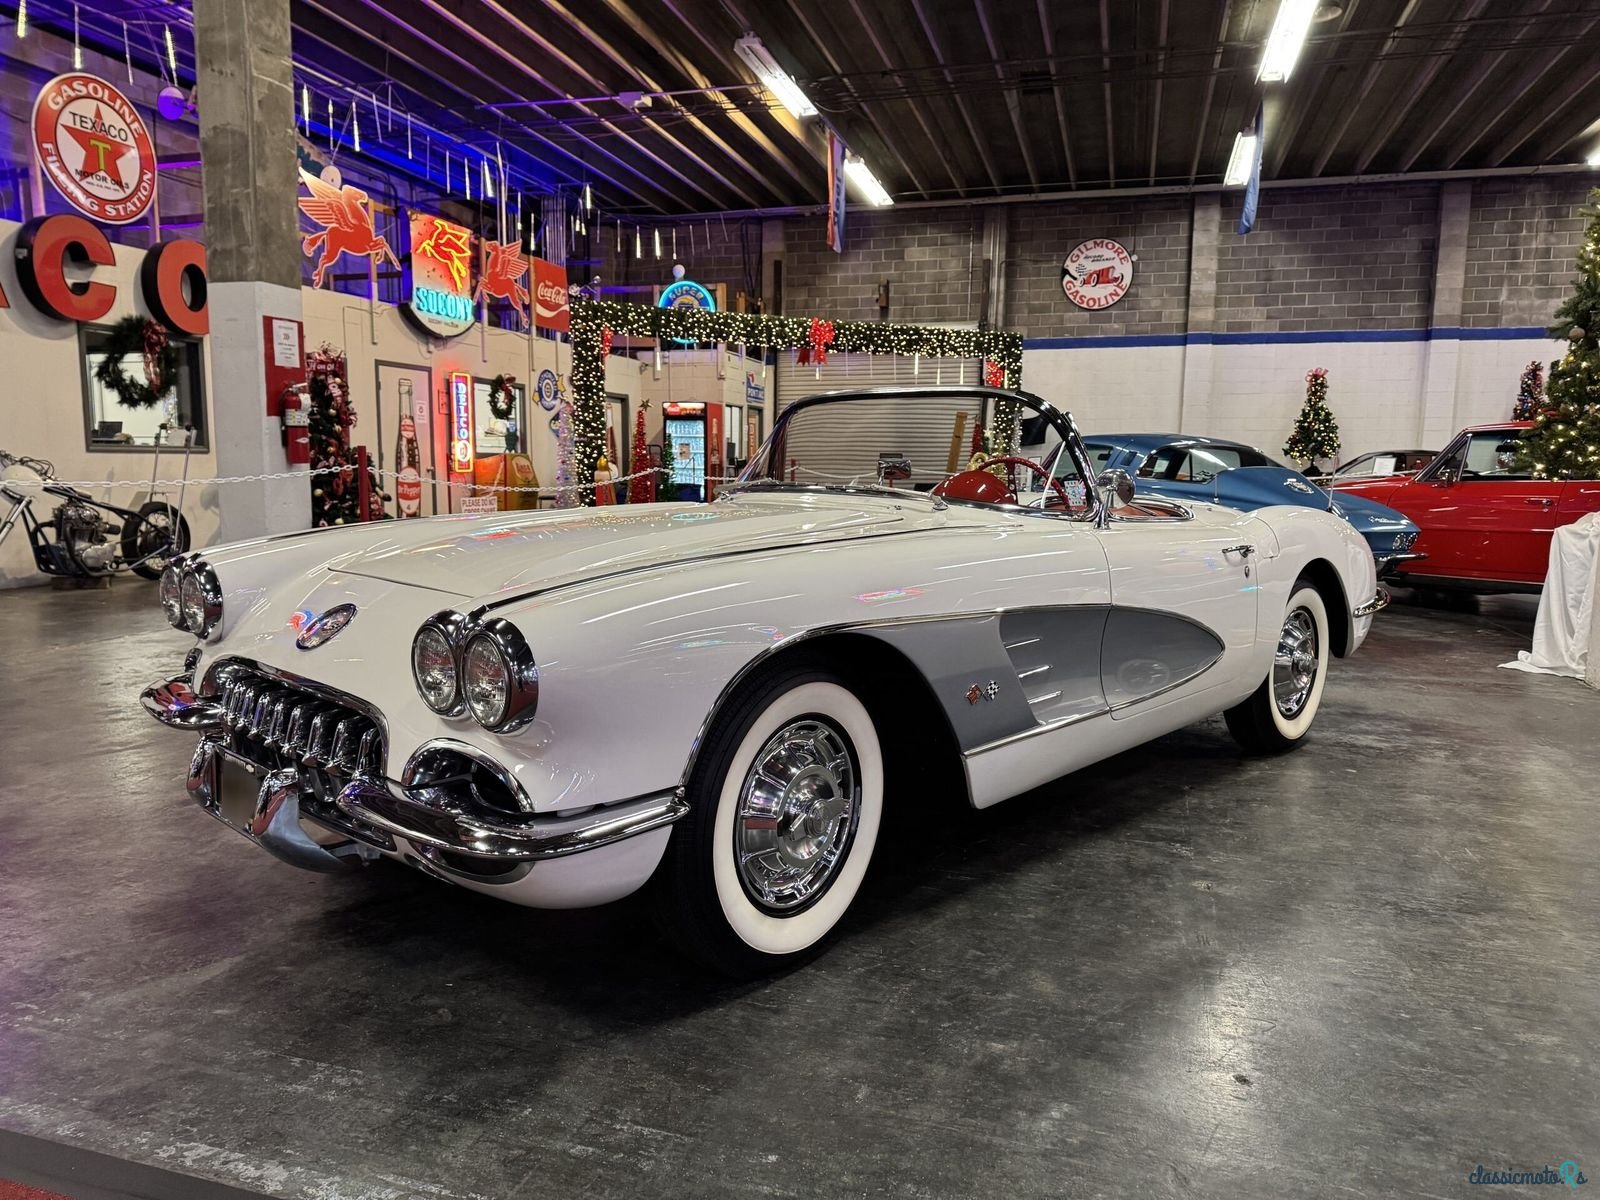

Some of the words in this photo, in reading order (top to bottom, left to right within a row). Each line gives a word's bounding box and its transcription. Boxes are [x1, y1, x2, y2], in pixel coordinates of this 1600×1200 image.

[47, 80, 144, 138] GASOLINE
[69, 111, 128, 142] TEXACO
[90, 139, 111, 170] T
[74, 168, 108, 184] MOTOR
[104, 169, 153, 216] STATION
[1070, 240, 1129, 265] GILMORE
[416, 287, 473, 321] SOCONY
[1065, 280, 1128, 308] GASOLINE
[456, 382, 468, 440] DELCO
[462, 498, 480, 507] PLEASE
[481, 498, 488, 506] DO
[488, 497, 496, 506] NOT
